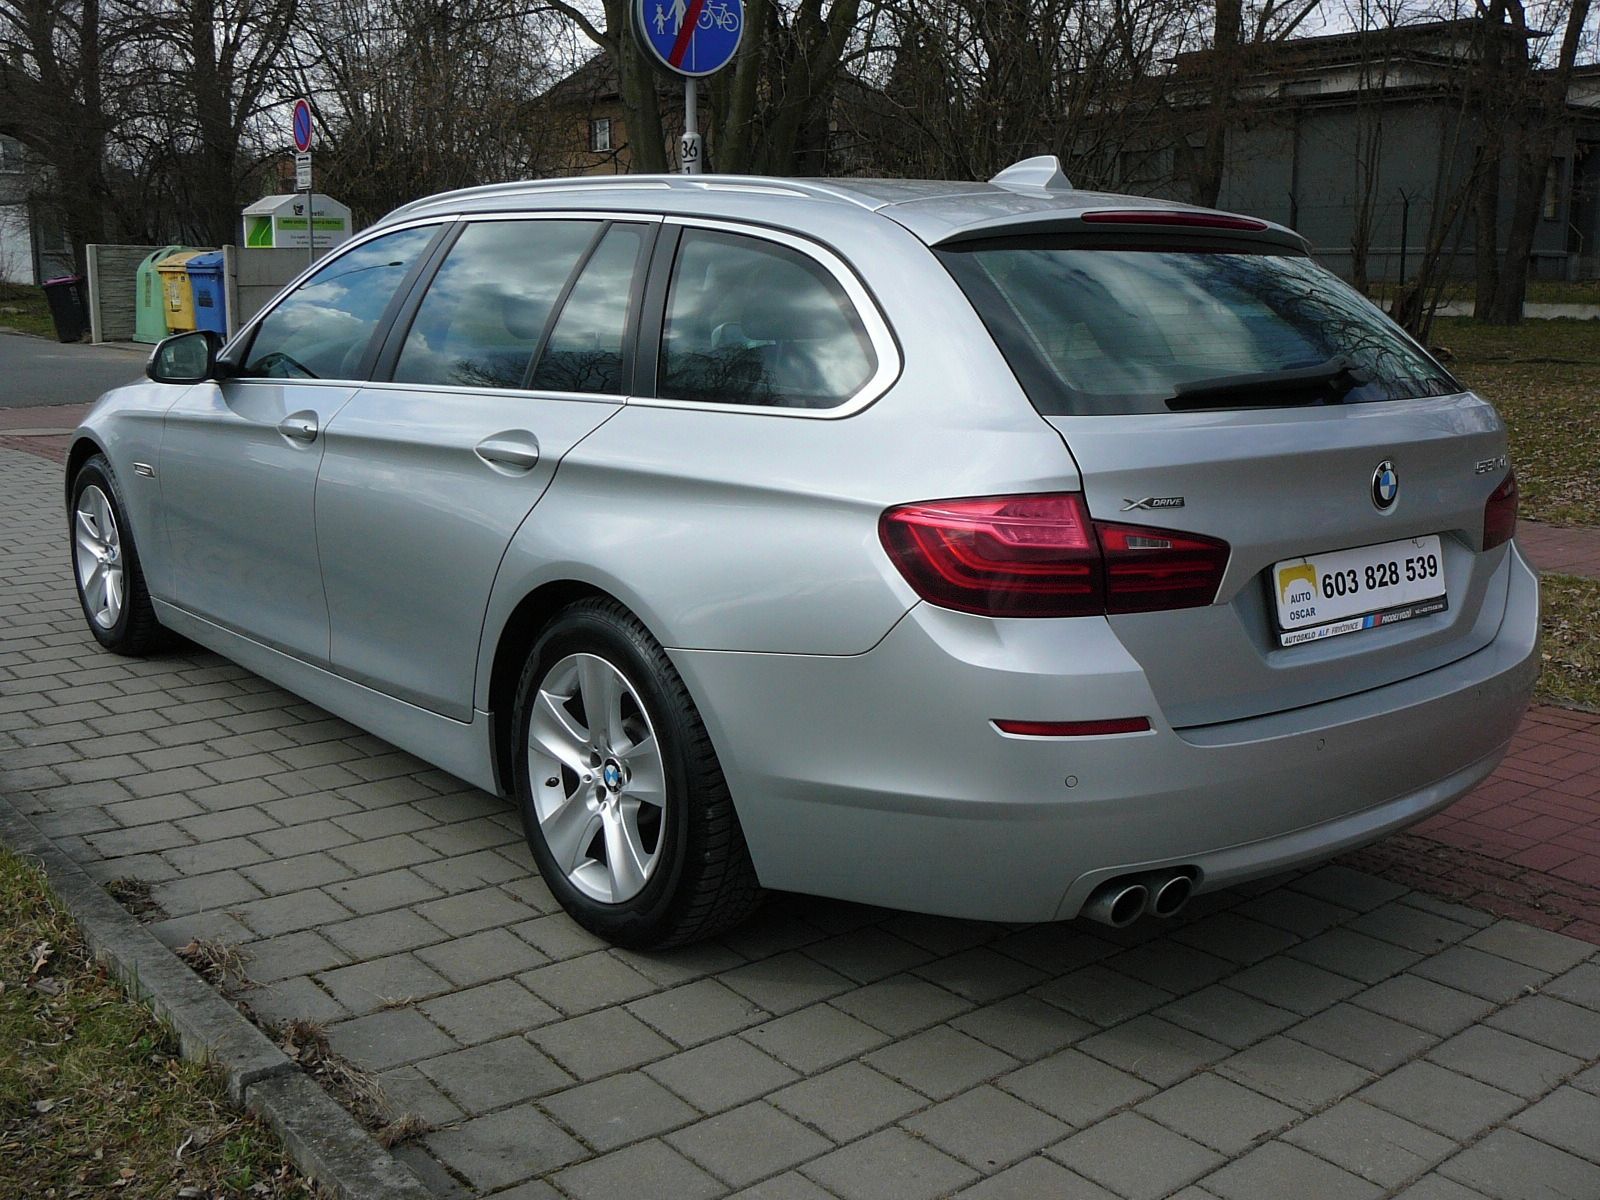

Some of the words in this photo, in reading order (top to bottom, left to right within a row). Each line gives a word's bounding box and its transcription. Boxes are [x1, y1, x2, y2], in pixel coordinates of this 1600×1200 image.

[682, 139, 698, 158] 36
[1322, 569, 1359, 599] 603
[1365, 561, 1400, 590] 828
[1405, 554, 1438, 582] 539
[1290, 591, 1311, 605] AUTO
[1289, 607, 1316, 621] OSCAR
